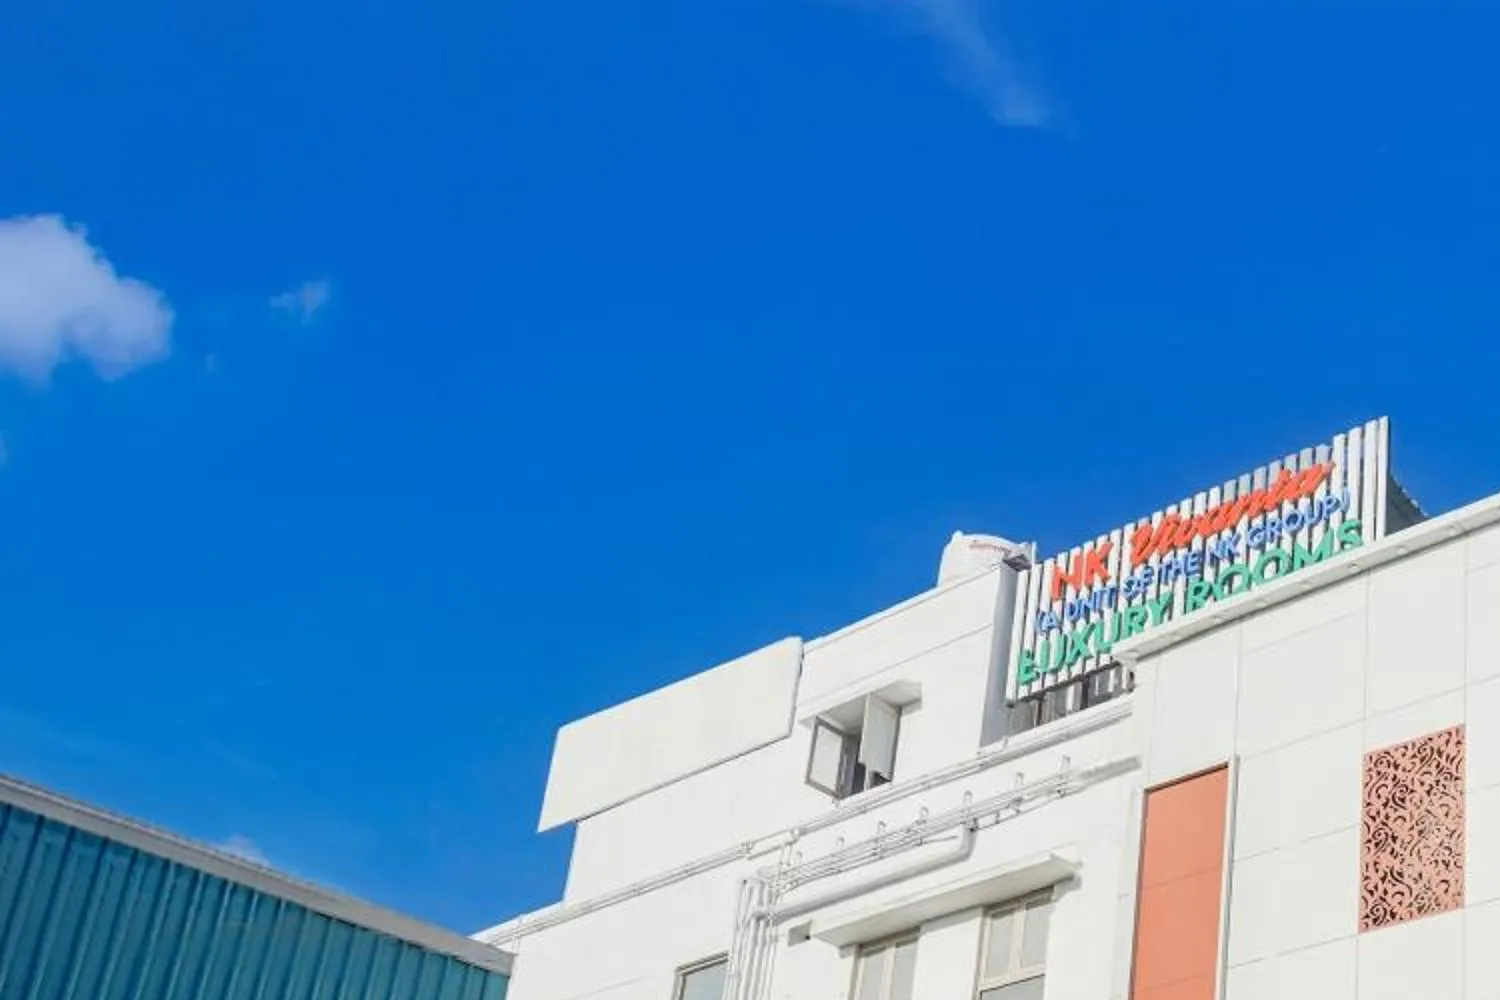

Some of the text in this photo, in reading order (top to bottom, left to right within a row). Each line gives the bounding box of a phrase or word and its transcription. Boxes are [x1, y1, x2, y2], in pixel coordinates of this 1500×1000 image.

[1050, 541, 1113, 600] NK
[1065, 583, 1118, 622] UNIT
[1121, 564, 1155, 600] OF
[1157, 550, 1202, 586] THE
[1204, 530, 1243, 565] NK
[1184, 518, 1363, 615] ROOMS
